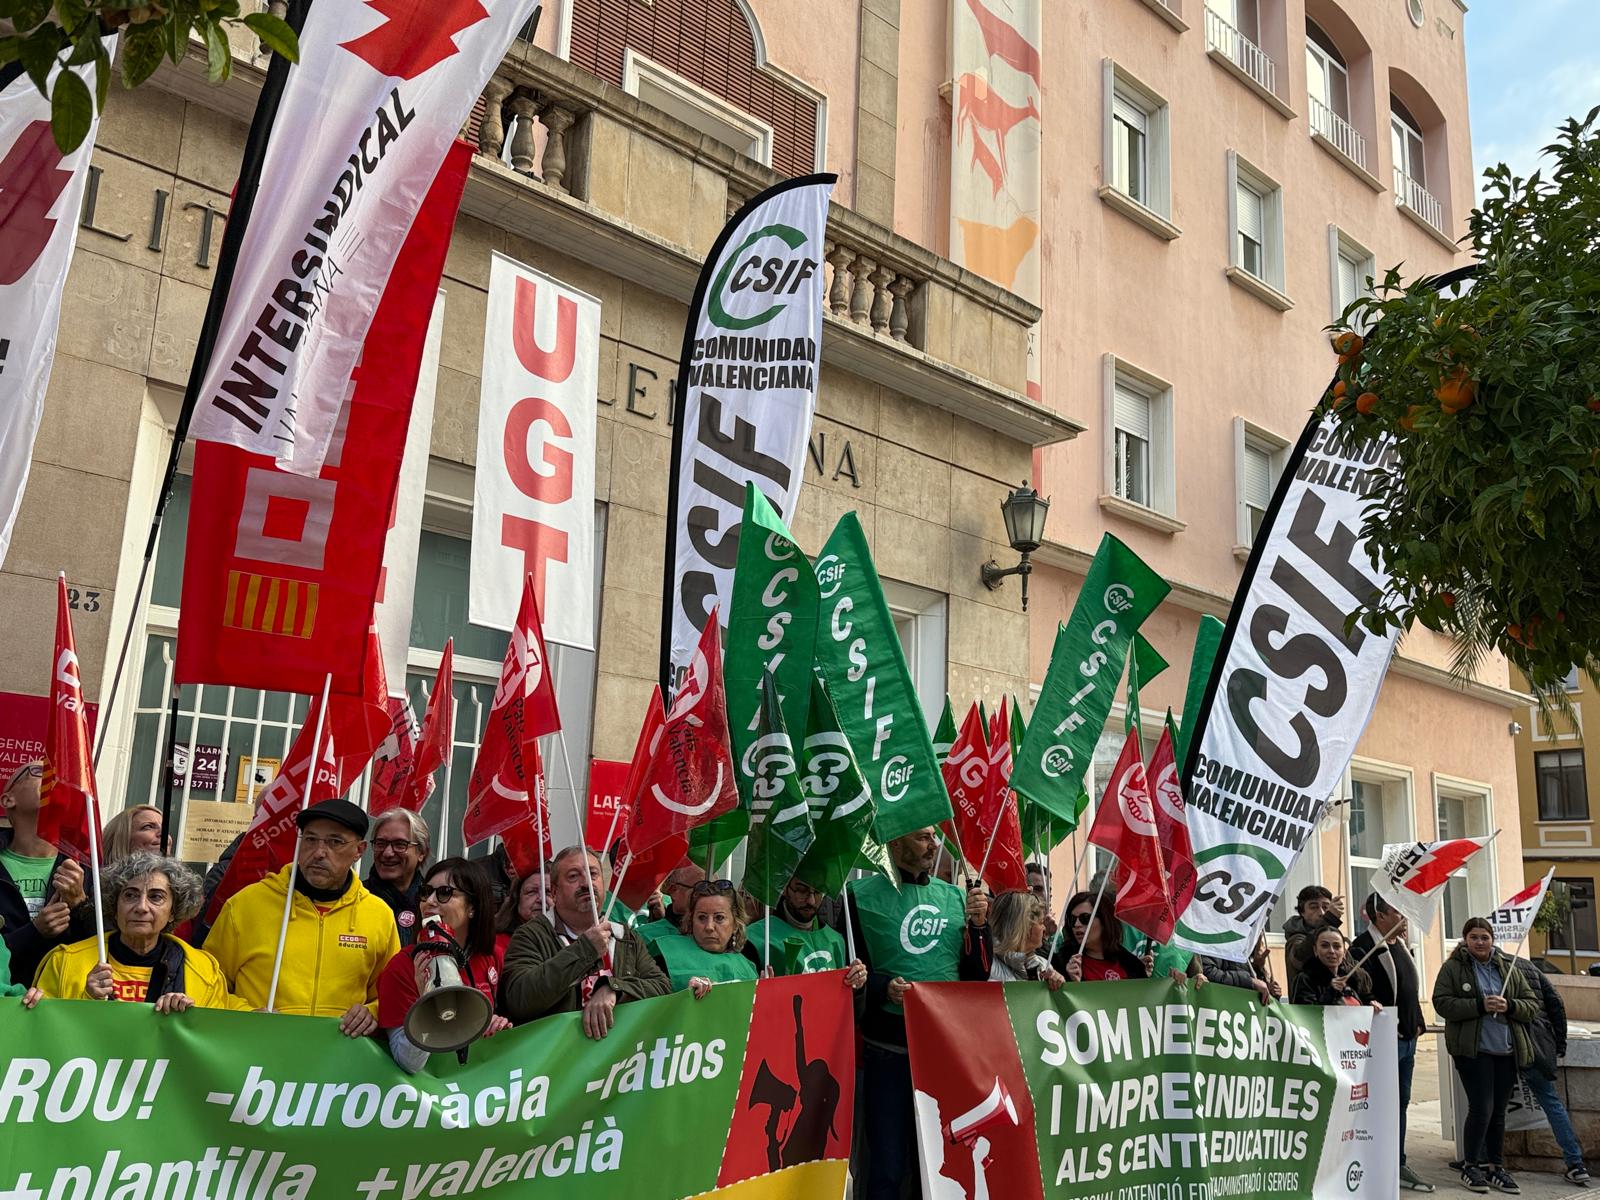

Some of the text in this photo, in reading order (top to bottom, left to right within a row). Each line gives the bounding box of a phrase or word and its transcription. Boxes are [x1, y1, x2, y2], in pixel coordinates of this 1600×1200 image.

[730, 255, 818, 295] CSIF
[688, 363, 814, 394] VALENCIANA
[692, 335, 816, 364] COMUNIDAD
[500, 275, 577, 624] UGT
[1227, 487, 1386, 789] CSIF
[831, 597, 894, 761] CSIF
[1053, 619, 1117, 737] CSIF
[1036, 1007, 1133, 1067] SOM
[205, 1065, 550, 1130] -burocràcia
[1049, 1084, 1063, 1136] I
[356, 1116, 625, 1200] +valencià
[1055, 1142, 1114, 1187] ALS
[1210, 1128, 1309, 1164] EDUCATIUS
[1268, 1171, 1299, 1192] SERVEIS
